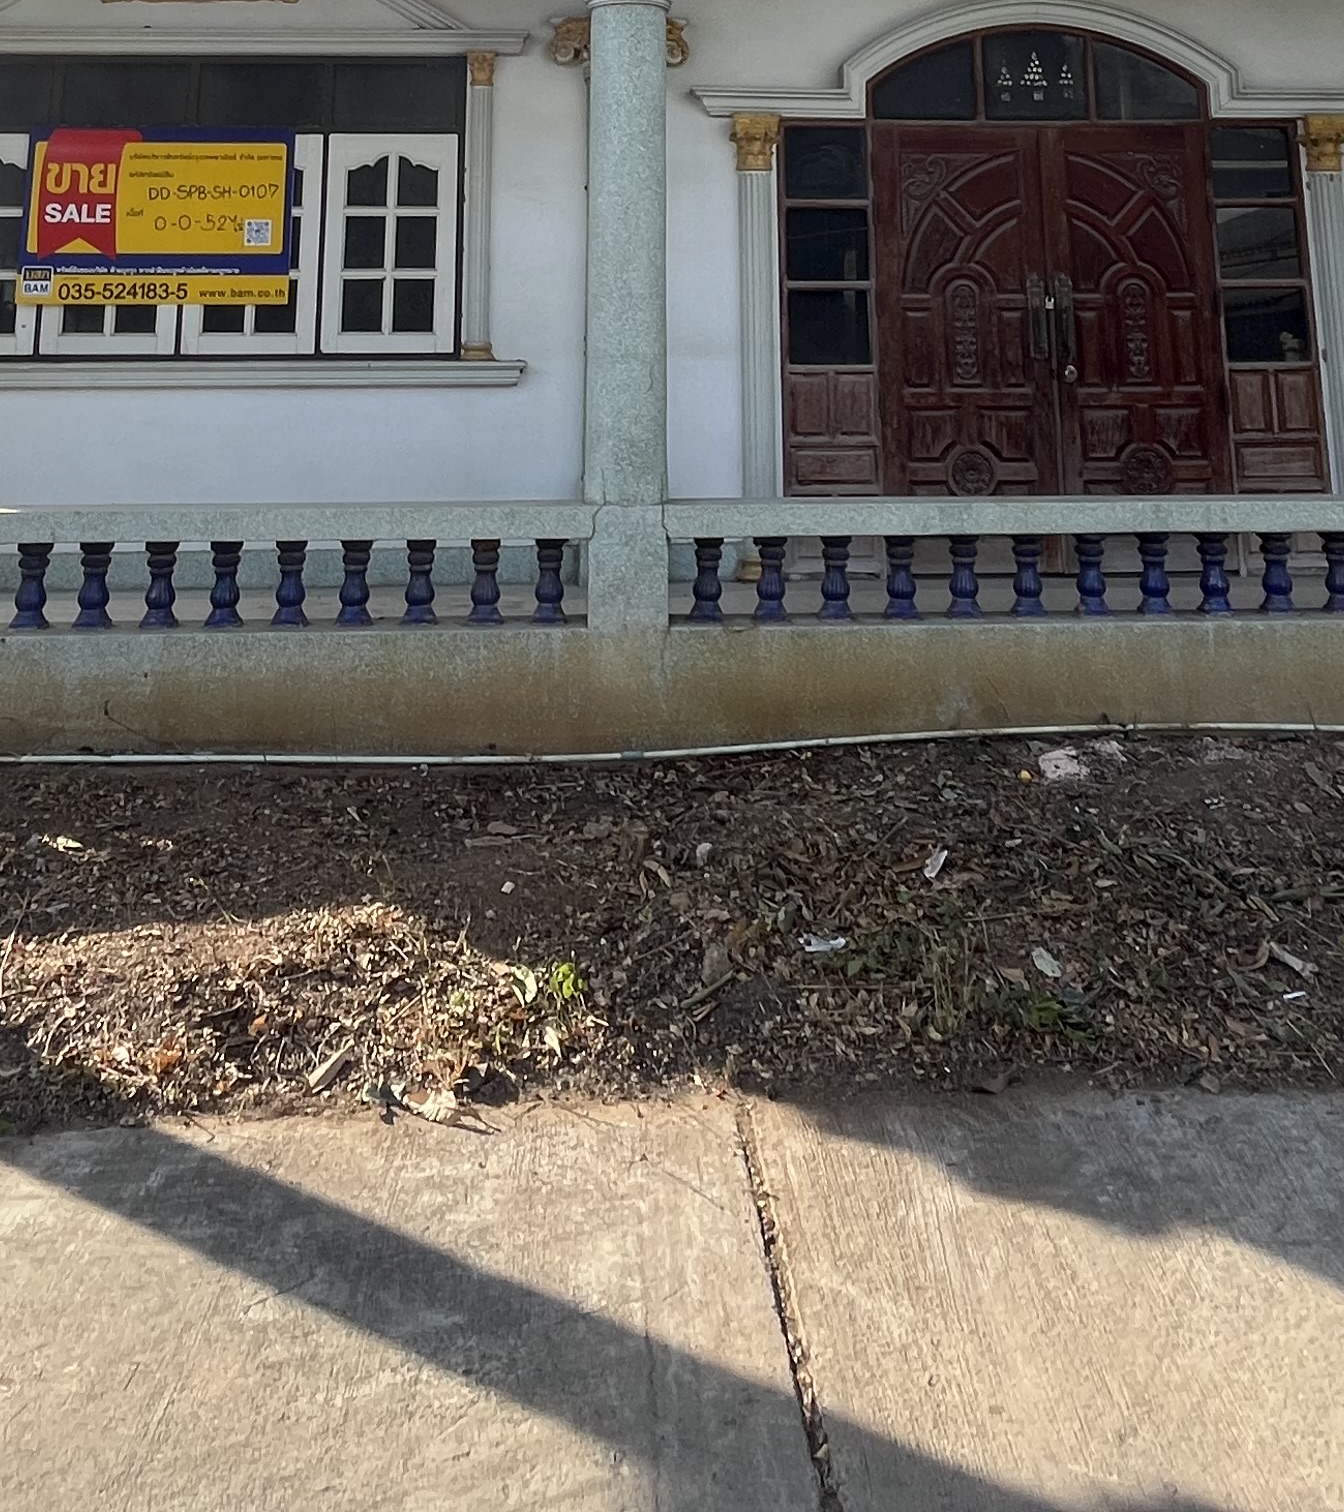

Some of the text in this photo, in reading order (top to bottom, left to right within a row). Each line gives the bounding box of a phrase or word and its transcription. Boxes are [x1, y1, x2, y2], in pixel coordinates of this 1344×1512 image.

[46, 162, 117, 194] ขาย
[44, 203, 112, 223] SALE
[24, 283, 49, 293] BAM
[58, 282, 188, 300] 035-524183-5
[199, 287, 286, 298] www.bam.co.th
